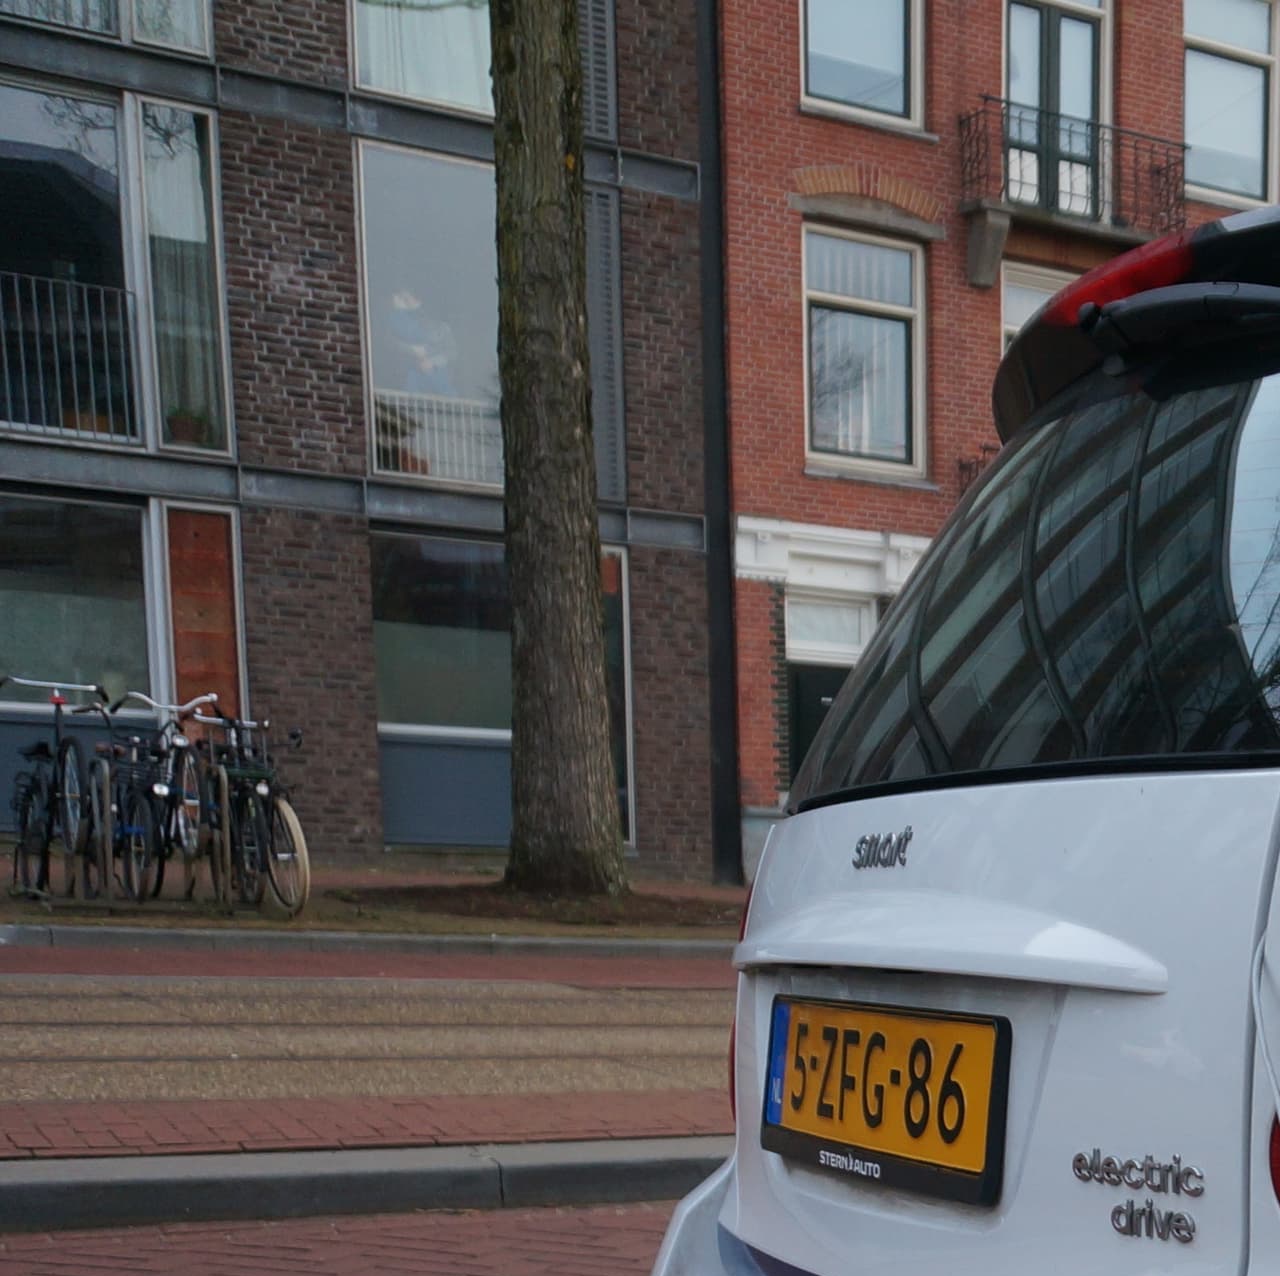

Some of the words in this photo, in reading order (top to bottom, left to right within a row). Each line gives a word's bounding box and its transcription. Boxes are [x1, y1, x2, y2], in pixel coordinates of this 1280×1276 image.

[852, 825, 913, 869] smart
[791, 1023, 965, 1144] 5-ZFG-86
[1072, 1148, 1204, 1197] electric
[1111, 1199, 1196, 1243] drive
